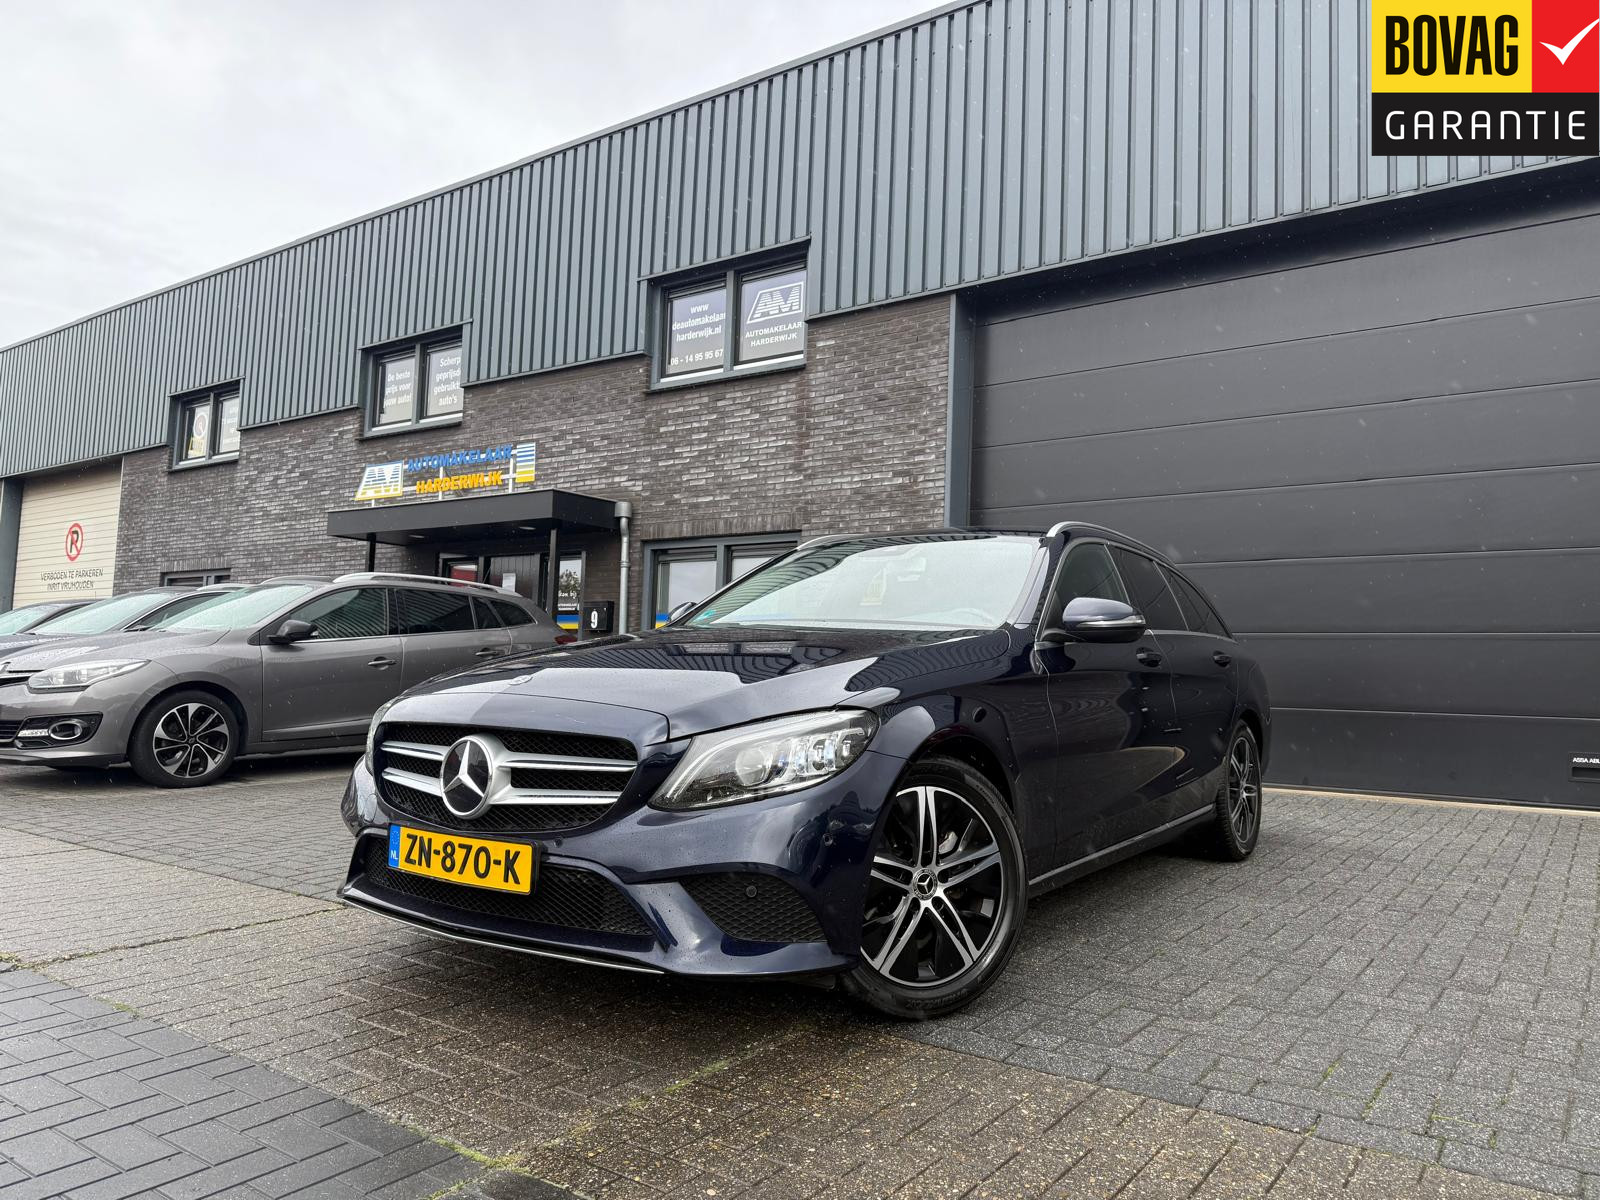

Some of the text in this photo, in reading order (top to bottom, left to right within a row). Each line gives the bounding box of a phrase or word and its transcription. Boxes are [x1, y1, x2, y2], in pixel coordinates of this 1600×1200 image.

[690, 303, 709, 314] www
[676, 325, 722, 342] harderwijk.nl
[745, 321, 802, 338] AUTOMAKELAAR
[750, 332, 798, 347] HARDERWIJK
[670, 356, 679, 366] 06
[685, 354, 693, 363] 14
[694, 352, 704, 362] 95
[704, 350, 714, 360] 95
[714, 348, 724, 358] 67
[407, 443, 513, 473] AUTOMAKELAAR
[415, 470, 503, 494] HARDERWIJK
[40, 568, 103, 581] VERBODEN TE PARKEREN
[590, 610, 598, 629] 9
[390, 850, 398, 860] NL
[404, 833, 521, 885] ZN-870-K
